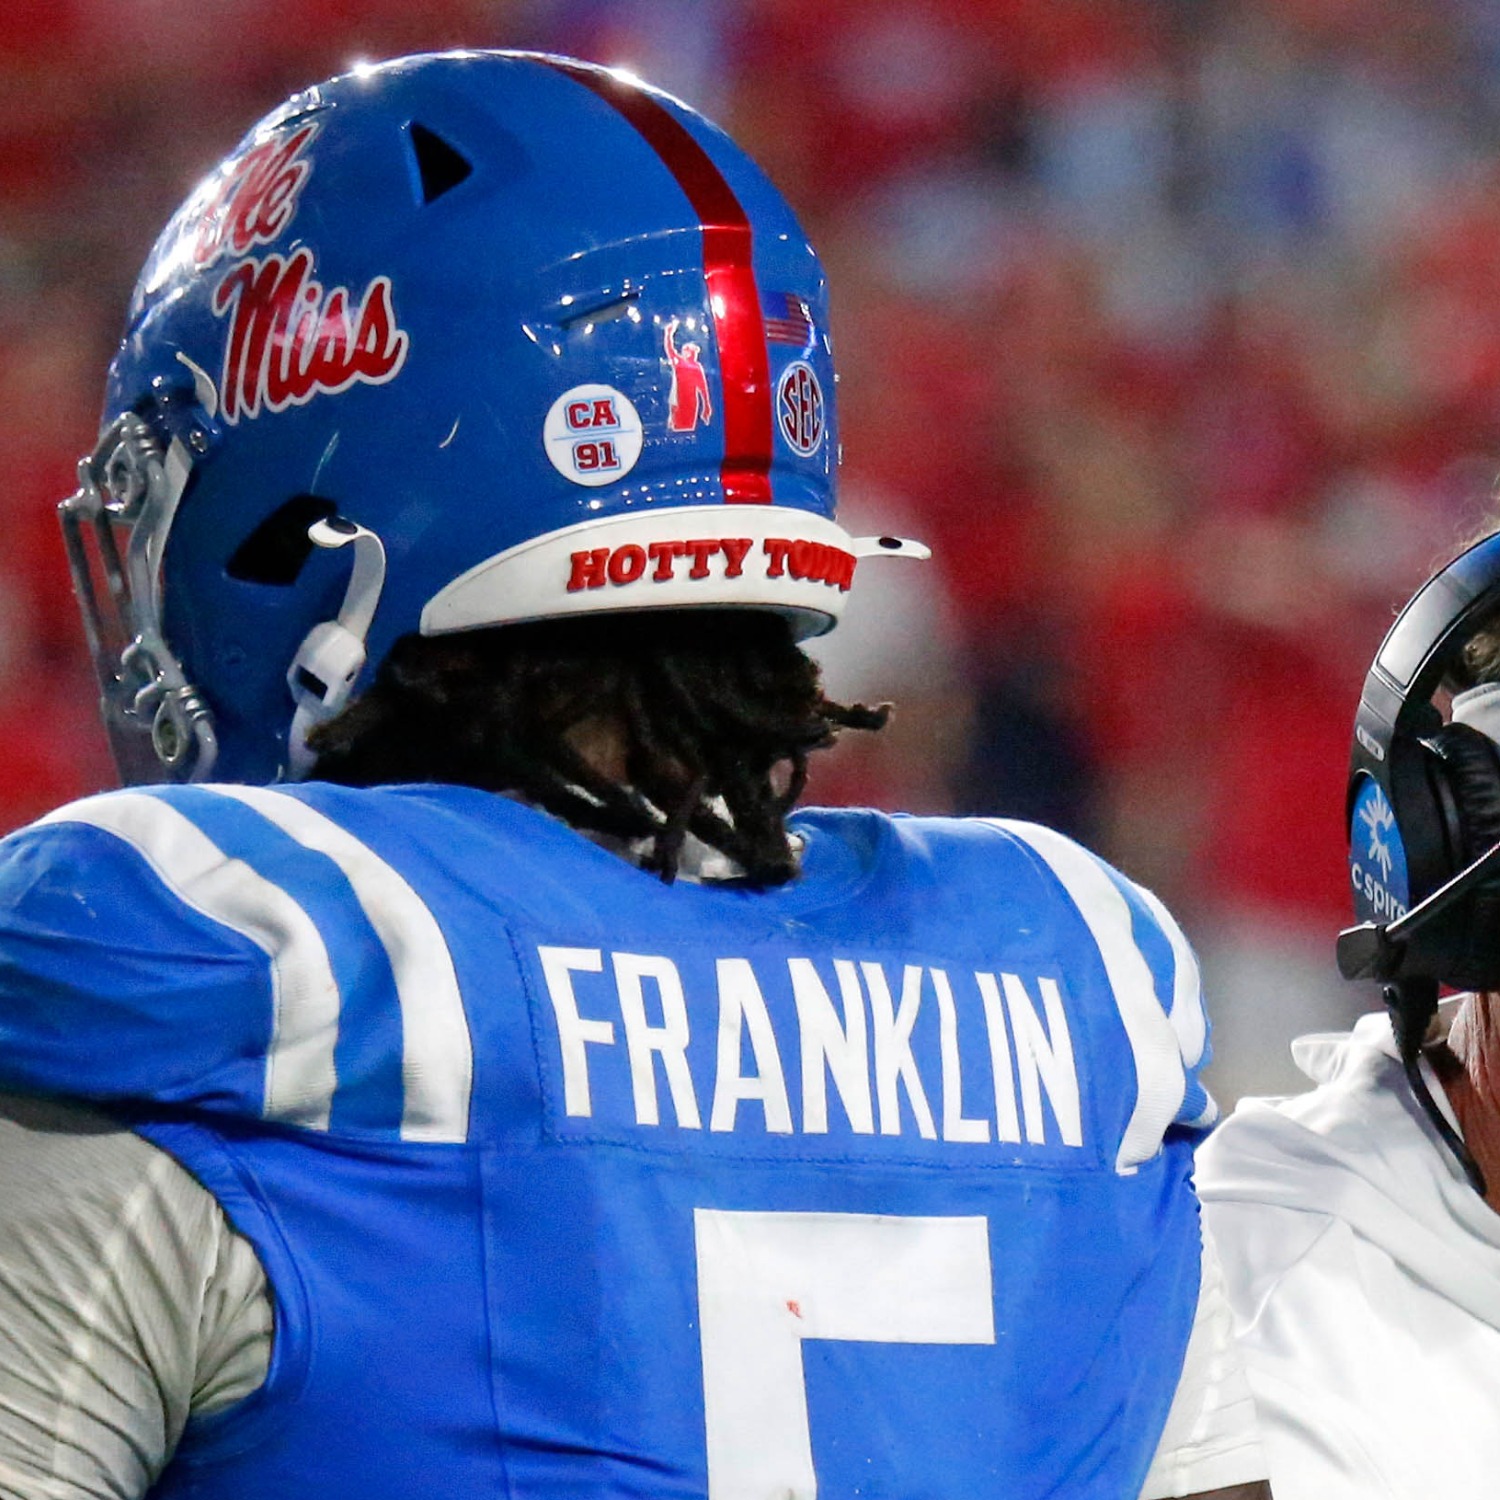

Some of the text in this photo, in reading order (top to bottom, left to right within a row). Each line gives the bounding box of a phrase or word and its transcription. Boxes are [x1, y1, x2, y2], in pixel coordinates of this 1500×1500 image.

[212, 248, 409, 425] Miss
[566, 398, 619, 431] CA
[780, 366, 823, 451] SEC
[575, 440, 619, 471] 91
[566, 538, 754, 592] HOTTY
[536, 944, 1086, 1149] FRANKLIN
